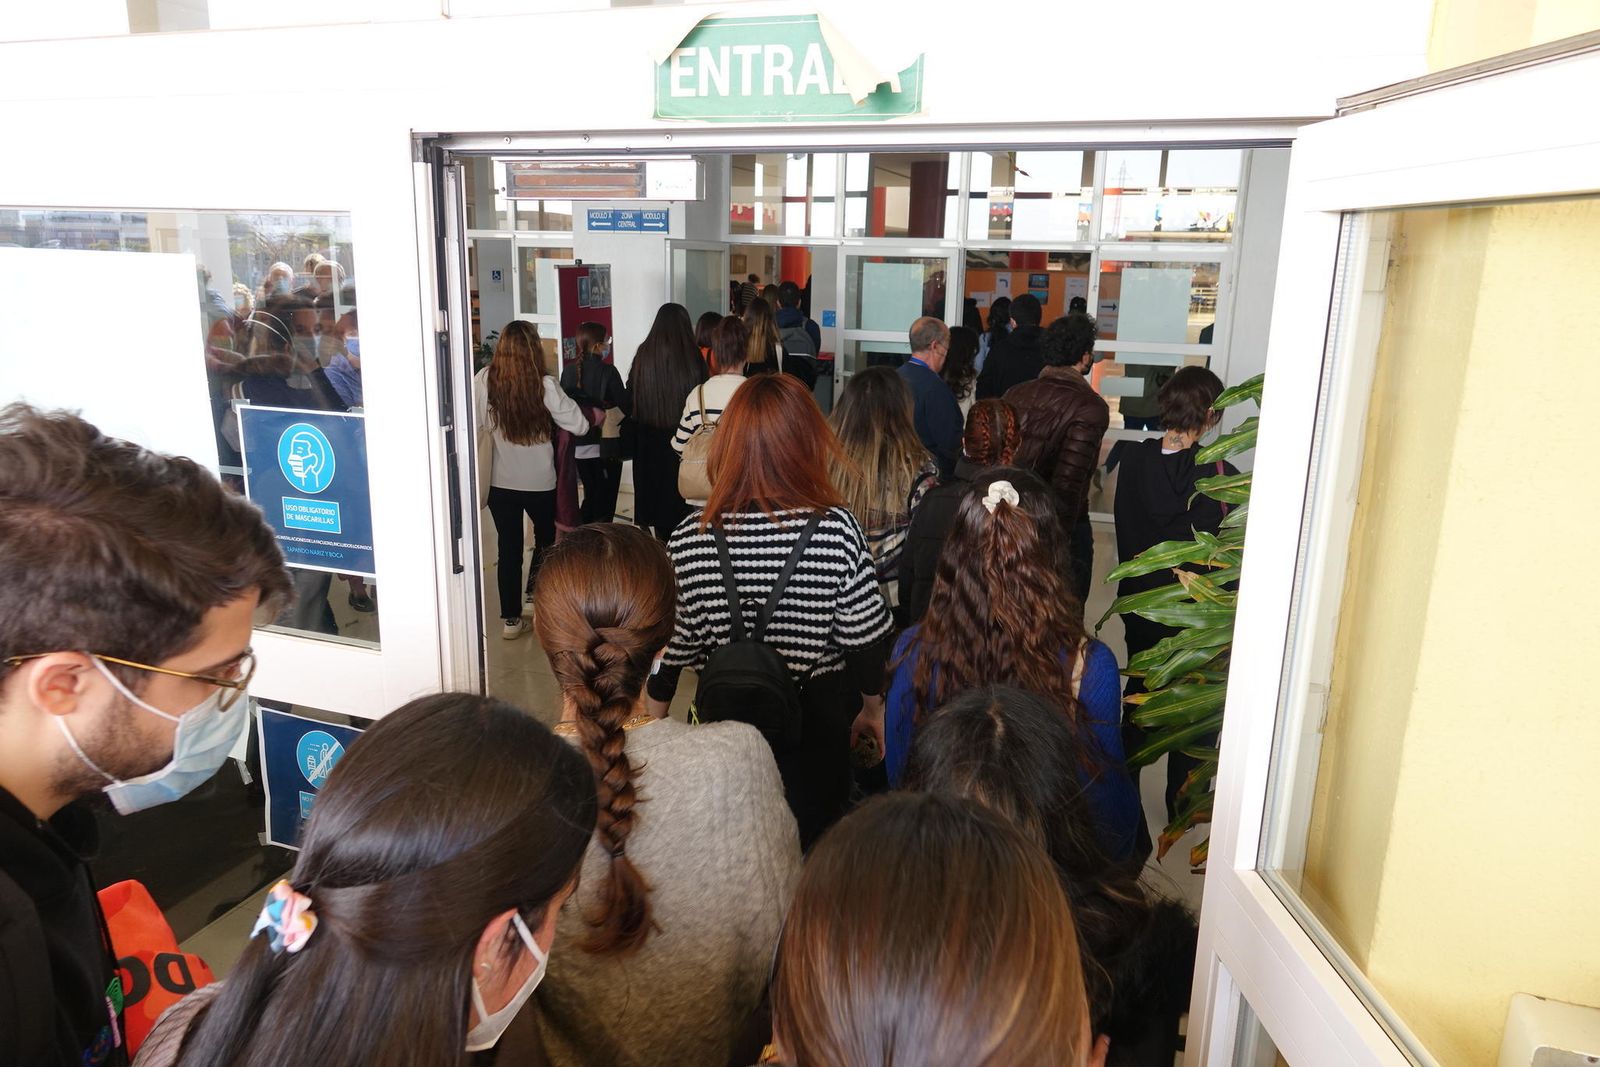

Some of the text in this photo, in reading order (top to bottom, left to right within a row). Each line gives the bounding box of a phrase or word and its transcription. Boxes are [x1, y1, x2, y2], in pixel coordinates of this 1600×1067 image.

[670, 42, 902, 98] ENTRA
[298, 505, 335, 515] OBLIGATORIO
[295, 514, 334, 524] MASCARILLAS
[287, 546, 310, 554] TAPANDO
[329, 551, 344, 559] BOCA
